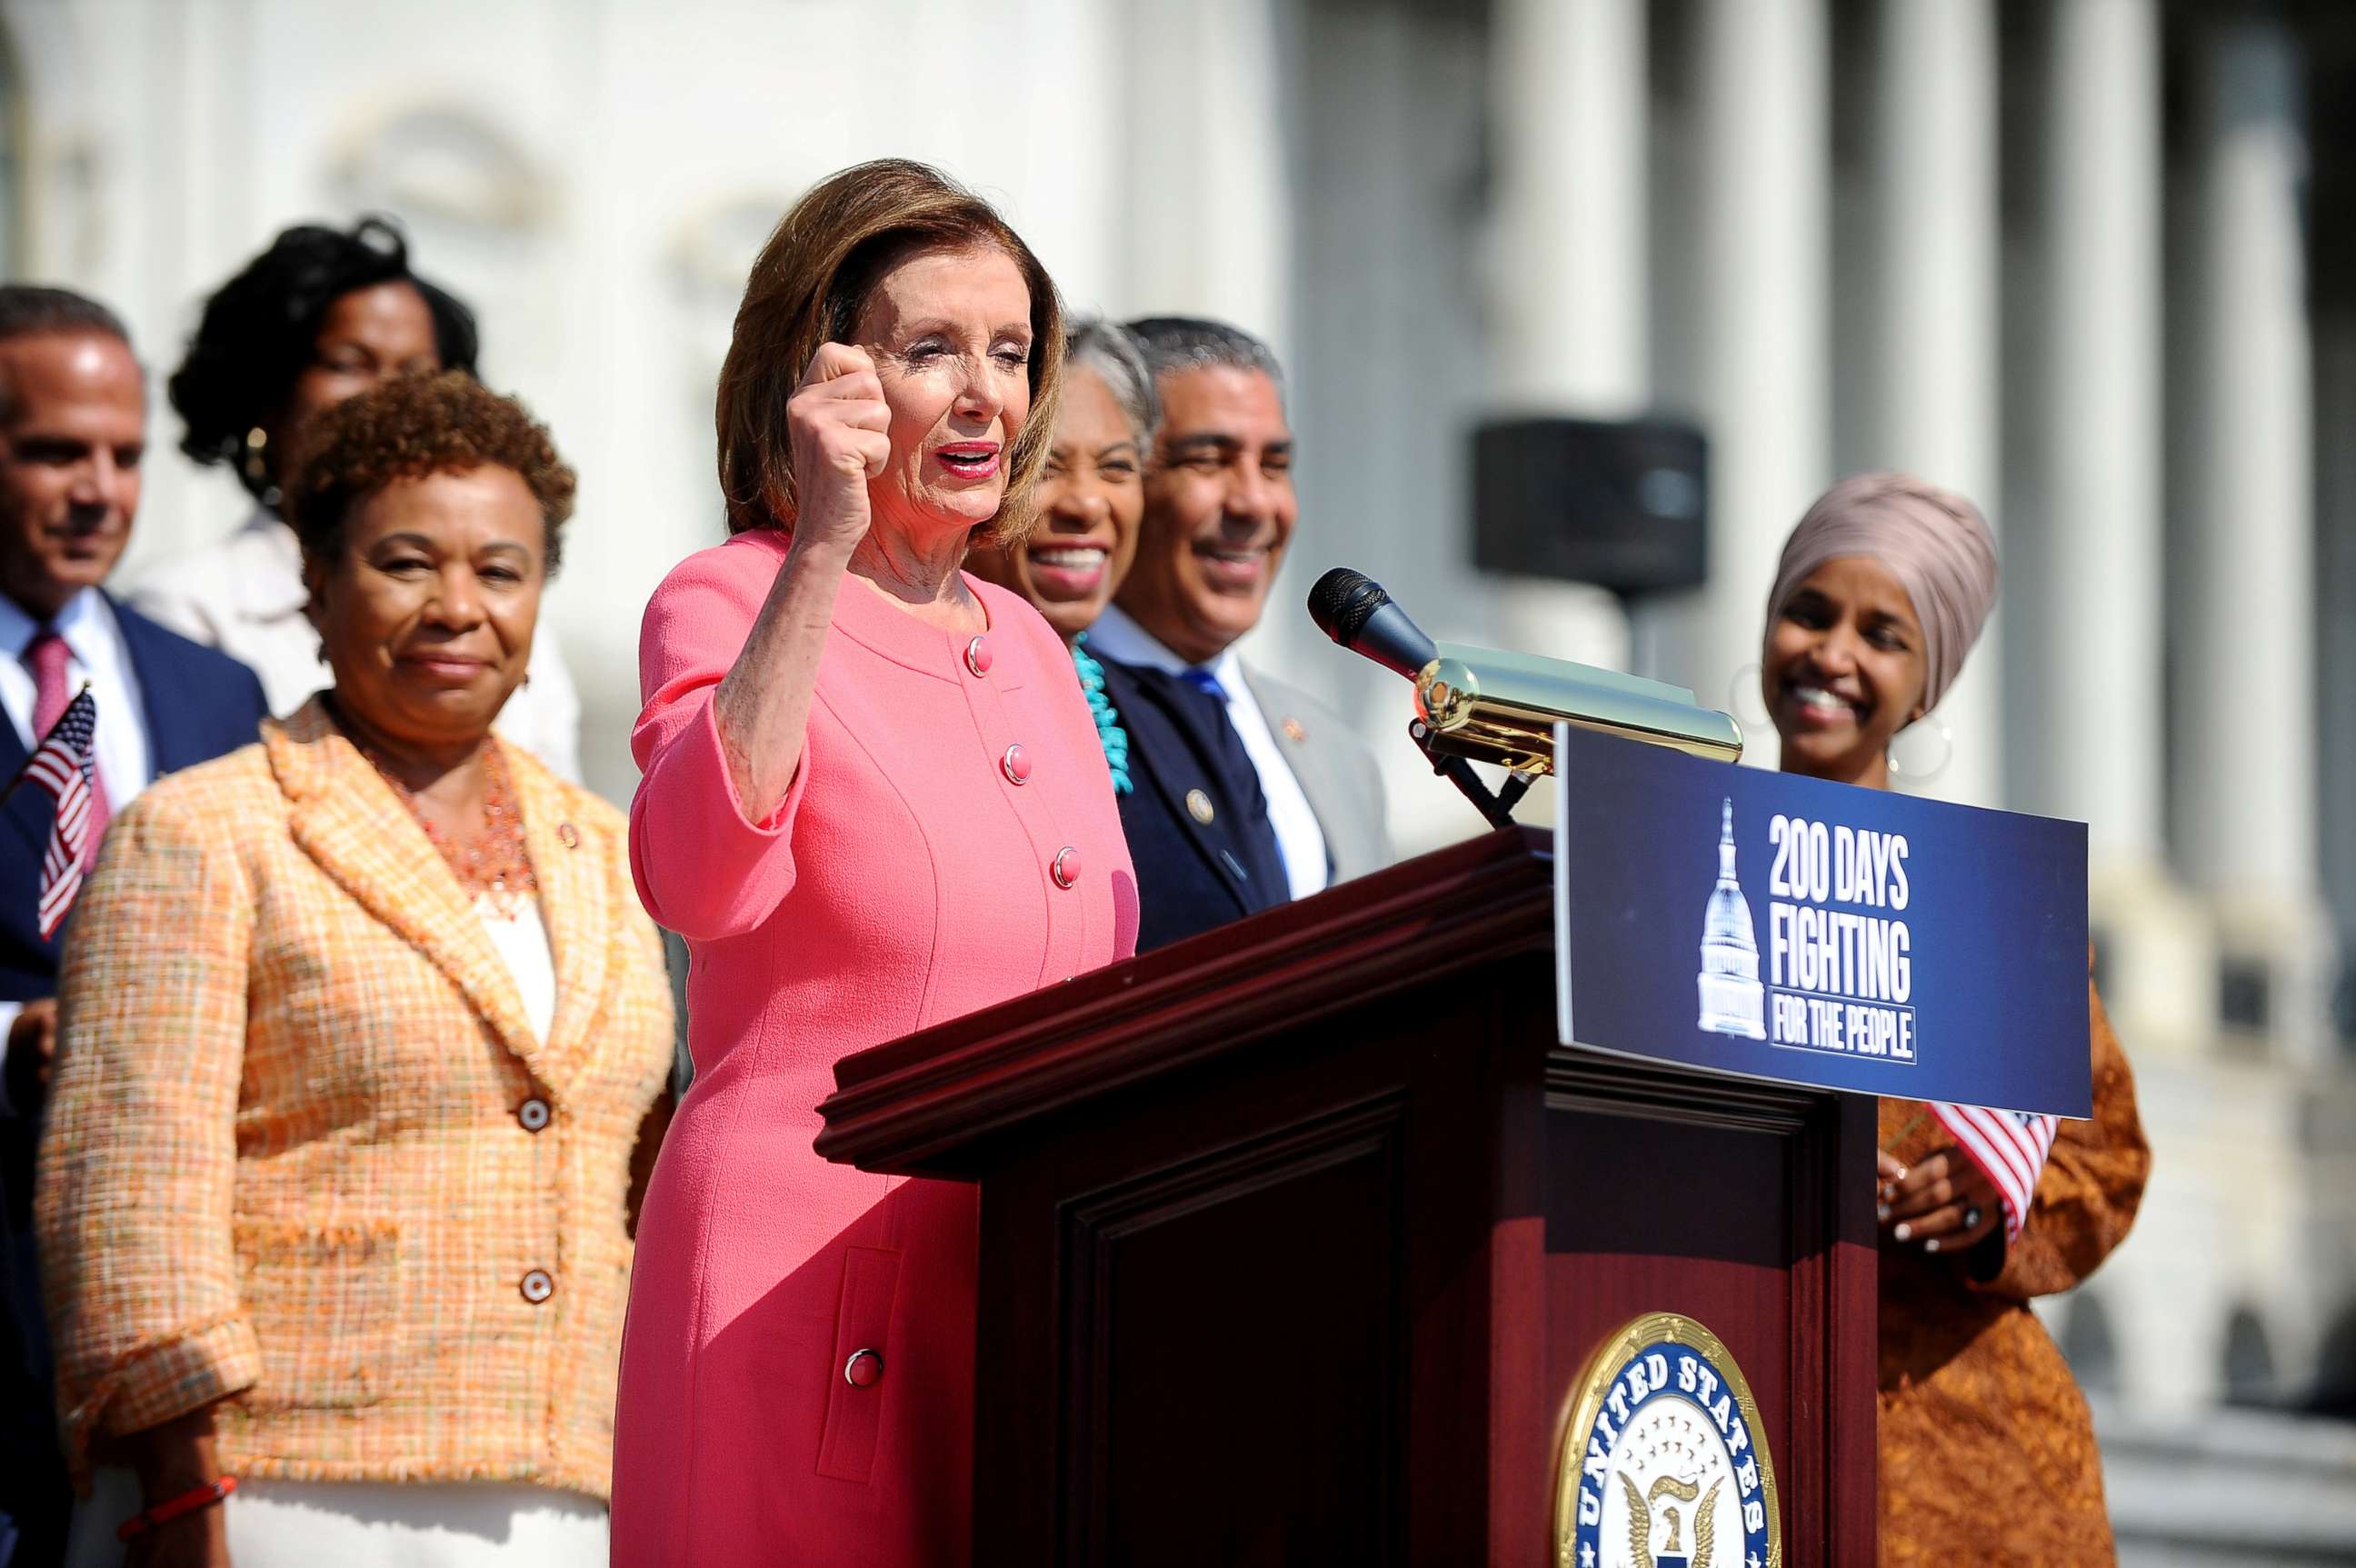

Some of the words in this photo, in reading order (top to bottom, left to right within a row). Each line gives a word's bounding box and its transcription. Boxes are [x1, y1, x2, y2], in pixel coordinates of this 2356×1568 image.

[1770, 814, 1830, 903] 200
[1834, 825, 1909, 911] DAYS
[1770, 902, 1911, 1004] FIGHTING
[1772, 993, 1808, 1045] FOR
[1808, 998, 1844, 1050] THE
[1846, 1004, 1912, 1059] PEOPLE
[1578, 1353, 1669, 1527] UNITED
[1678, 1355, 1764, 1534] STATES
